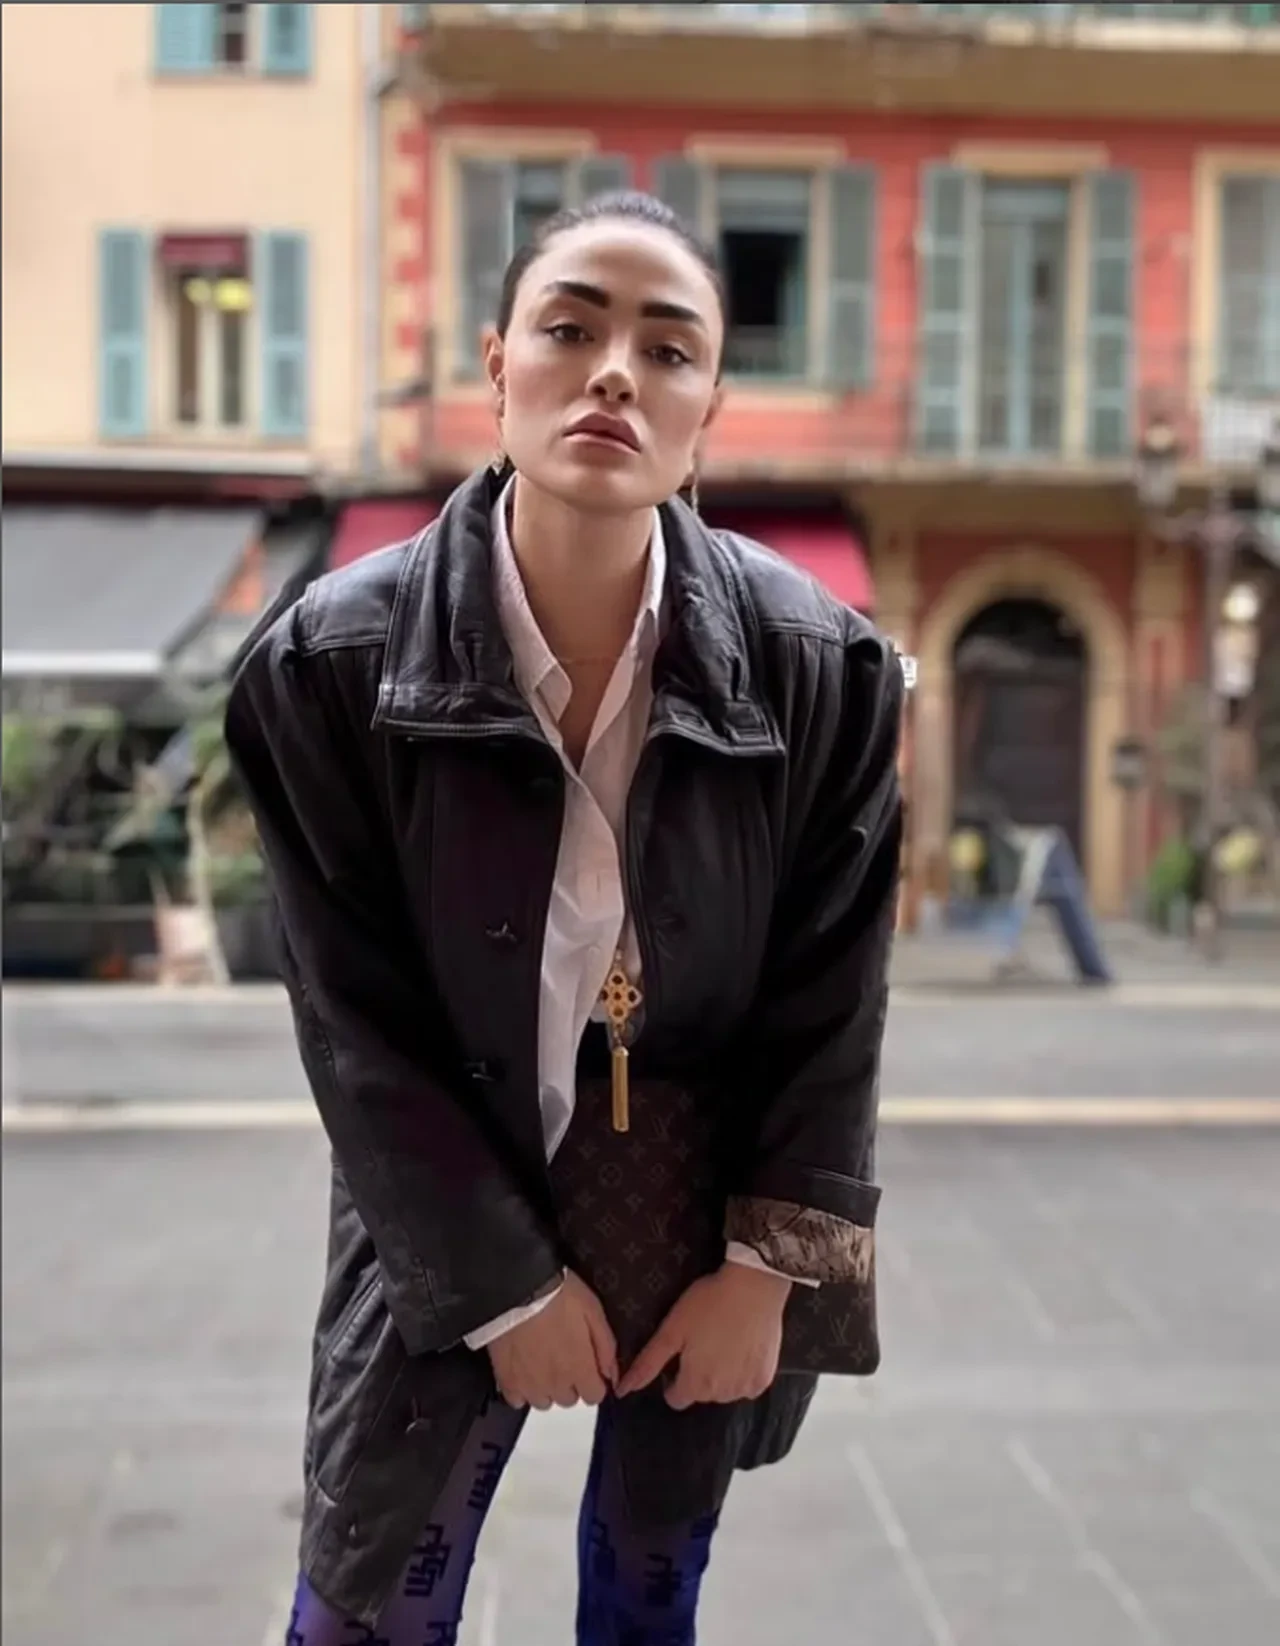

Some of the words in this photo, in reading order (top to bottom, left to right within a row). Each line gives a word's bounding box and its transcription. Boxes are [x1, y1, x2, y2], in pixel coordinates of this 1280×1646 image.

[648, 1112, 675, 1143] LV
[644, 1211, 672, 1244] LV
[828, 1313, 853, 1347] LV
